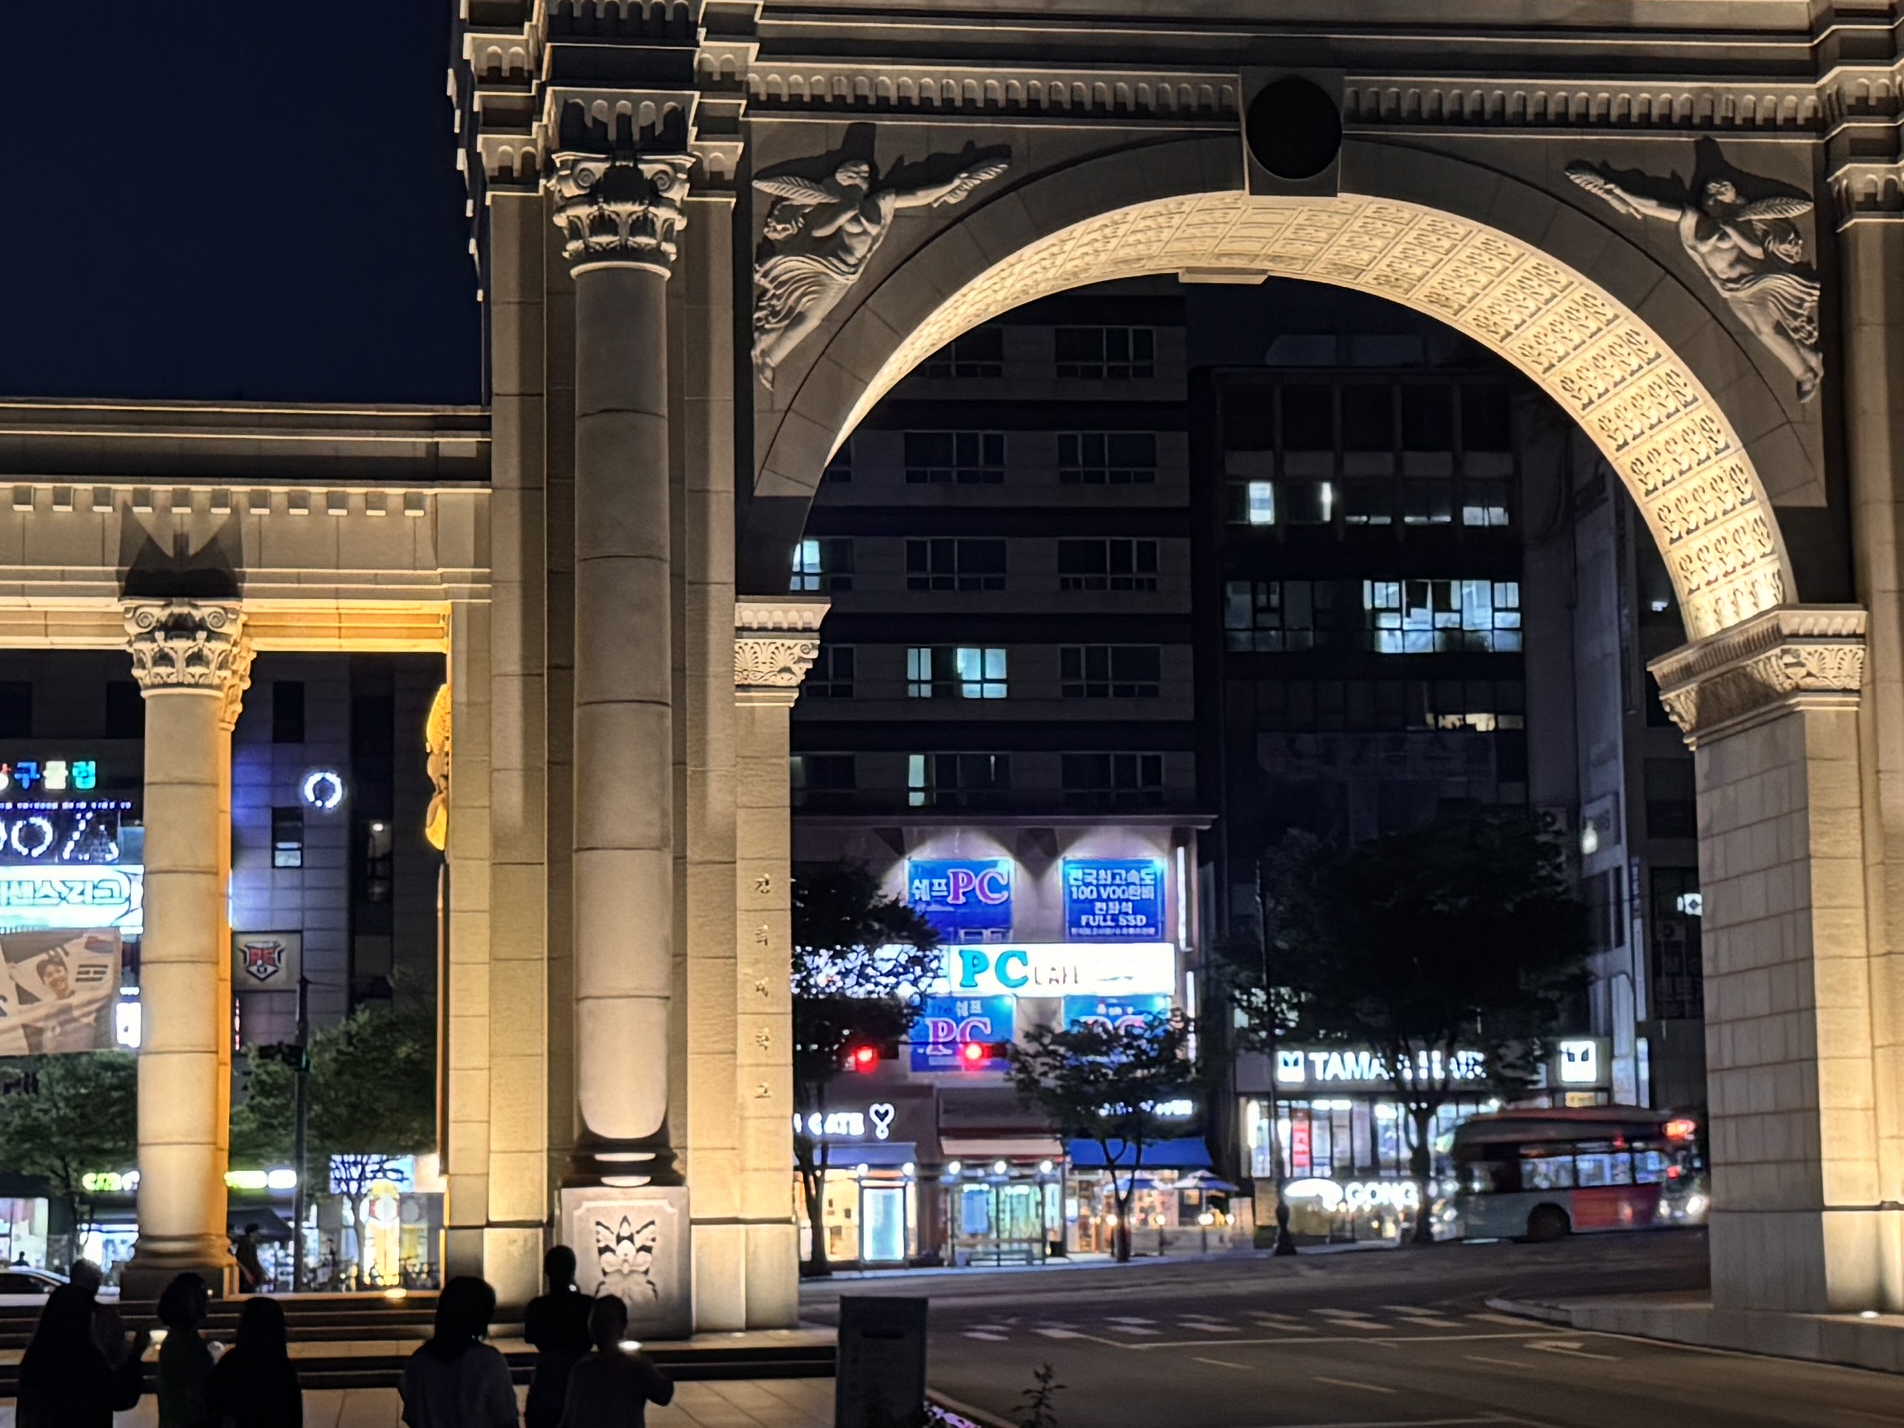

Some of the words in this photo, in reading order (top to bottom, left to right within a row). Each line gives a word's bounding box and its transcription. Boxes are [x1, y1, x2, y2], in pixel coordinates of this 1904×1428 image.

[1081, 915, 1115, 926] FULL
[1118, 915, 1147, 926] SSD
[959, 949, 1029, 989] PC
